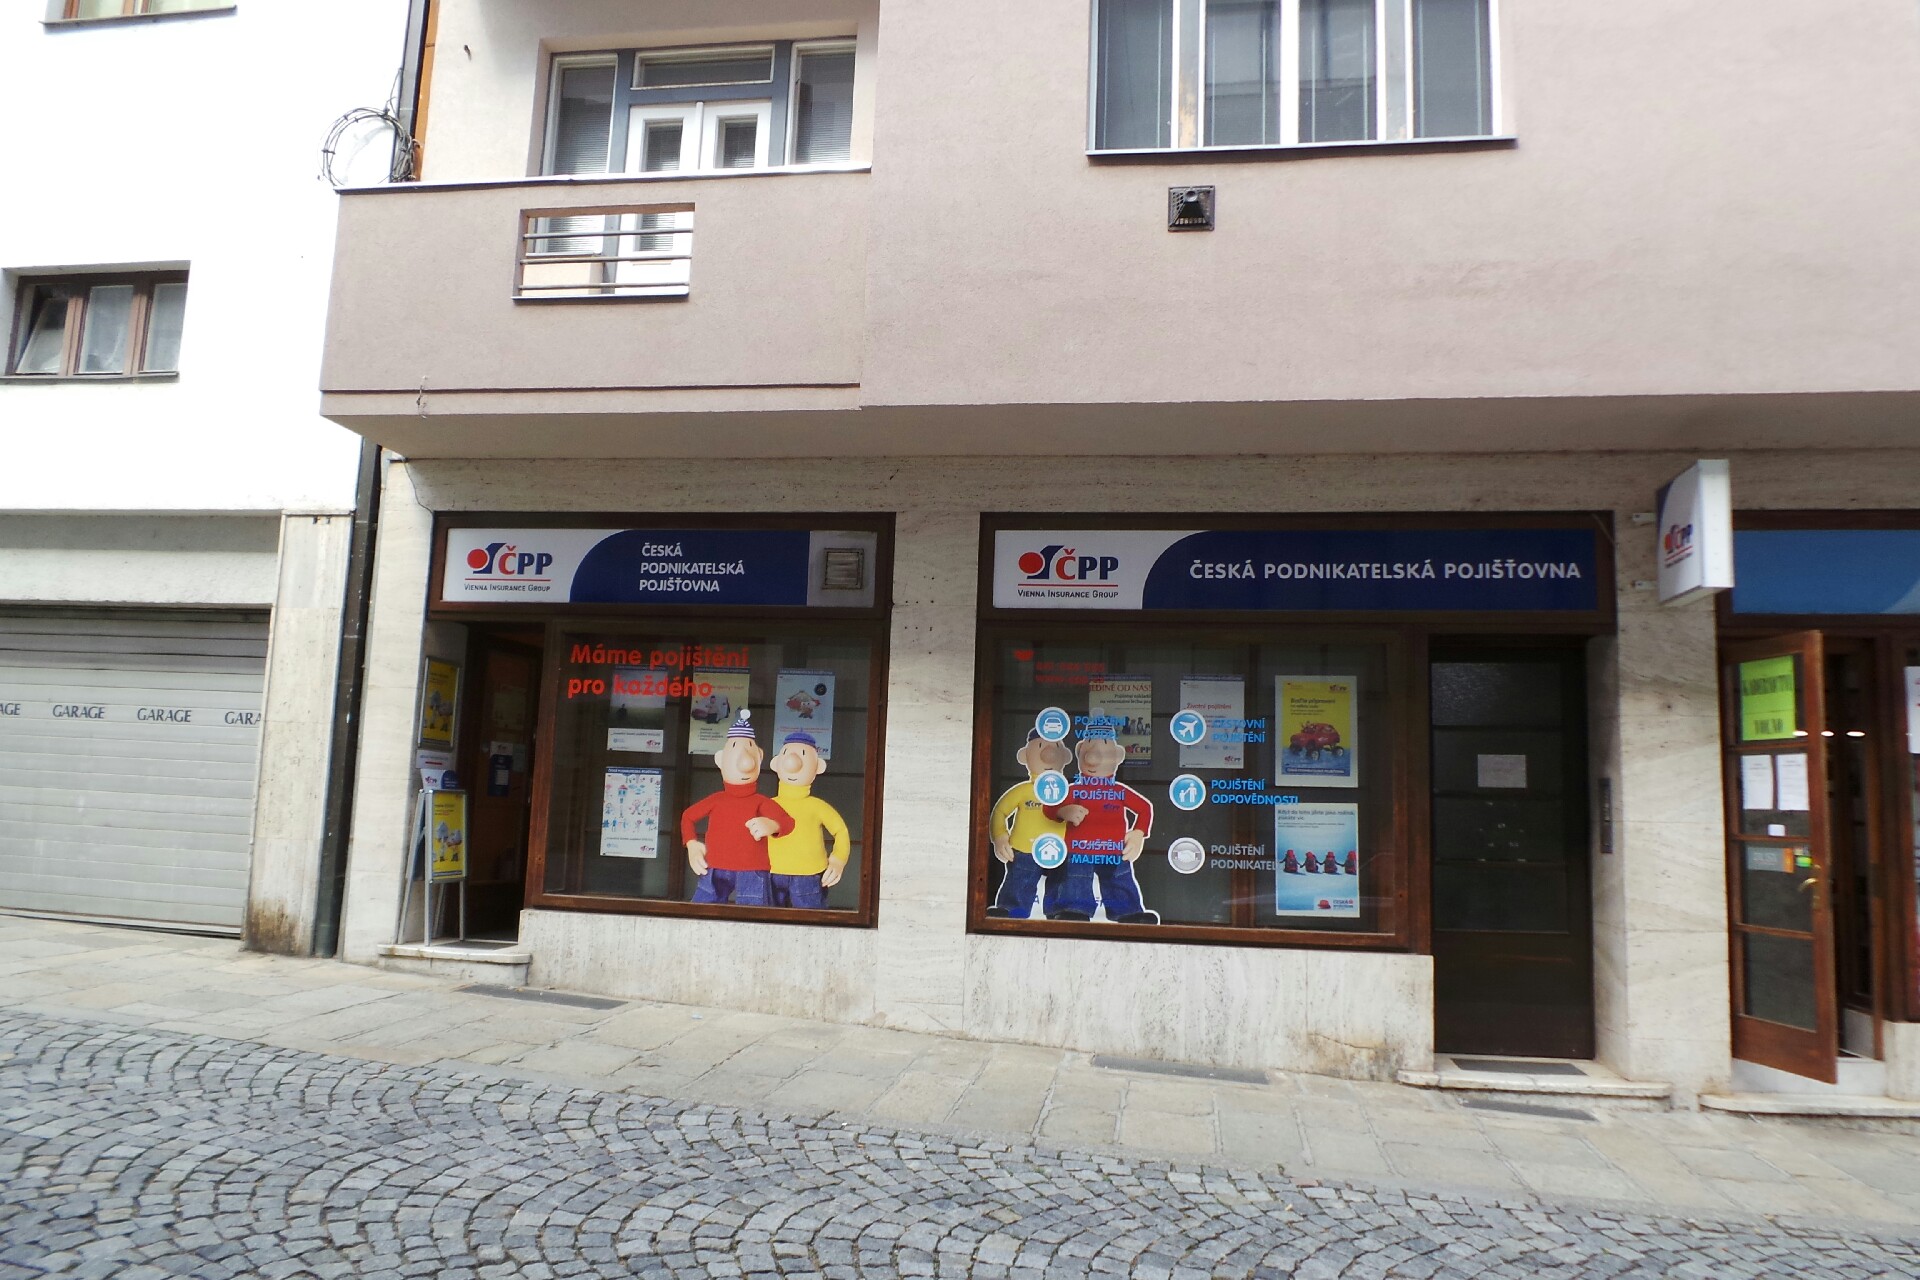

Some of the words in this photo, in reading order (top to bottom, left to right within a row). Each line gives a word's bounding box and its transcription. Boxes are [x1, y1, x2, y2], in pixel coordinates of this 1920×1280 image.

[641, 542, 683, 557] ČESKÁ
[498, 545, 553, 575] ČPP
[640, 560, 745, 575] PODNIKATELSKÁ
[1055, 548, 1119, 580] ČPP
[1189, 559, 1256, 579] ČESKÁ
[1264, 559, 1436, 579] PODNIKATELSKÁ
[1444, 558, 1582, 579] POJIŠŤOVNA
[639, 577, 720, 592] POJIŠŤOVNA
[570, 643, 643, 665] Máme
[650, 645, 749, 671] pojištění
[567, 678, 606, 699] pro
[613, 674, 713, 697] každého
[52, 704, 106, 719] GARAGE
[137, 707, 192, 723] GARAGE
[1073, 773, 1116, 786] ŽIVOTNÍ
[1211, 778, 1265, 791] POJIŠTĚNÍ
[1072, 788, 1125, 800] POJIŠTĚNÍ
[1211, 793, 1298, 805] ODPOVĚDNOSTI
[1071, 839, 1124, 851] POJIŠTĚNÍ
[1211, 843, 1265, 856] POJIŠTĚNÍ
[1071, 854, 1121, 865] MAJETKU
